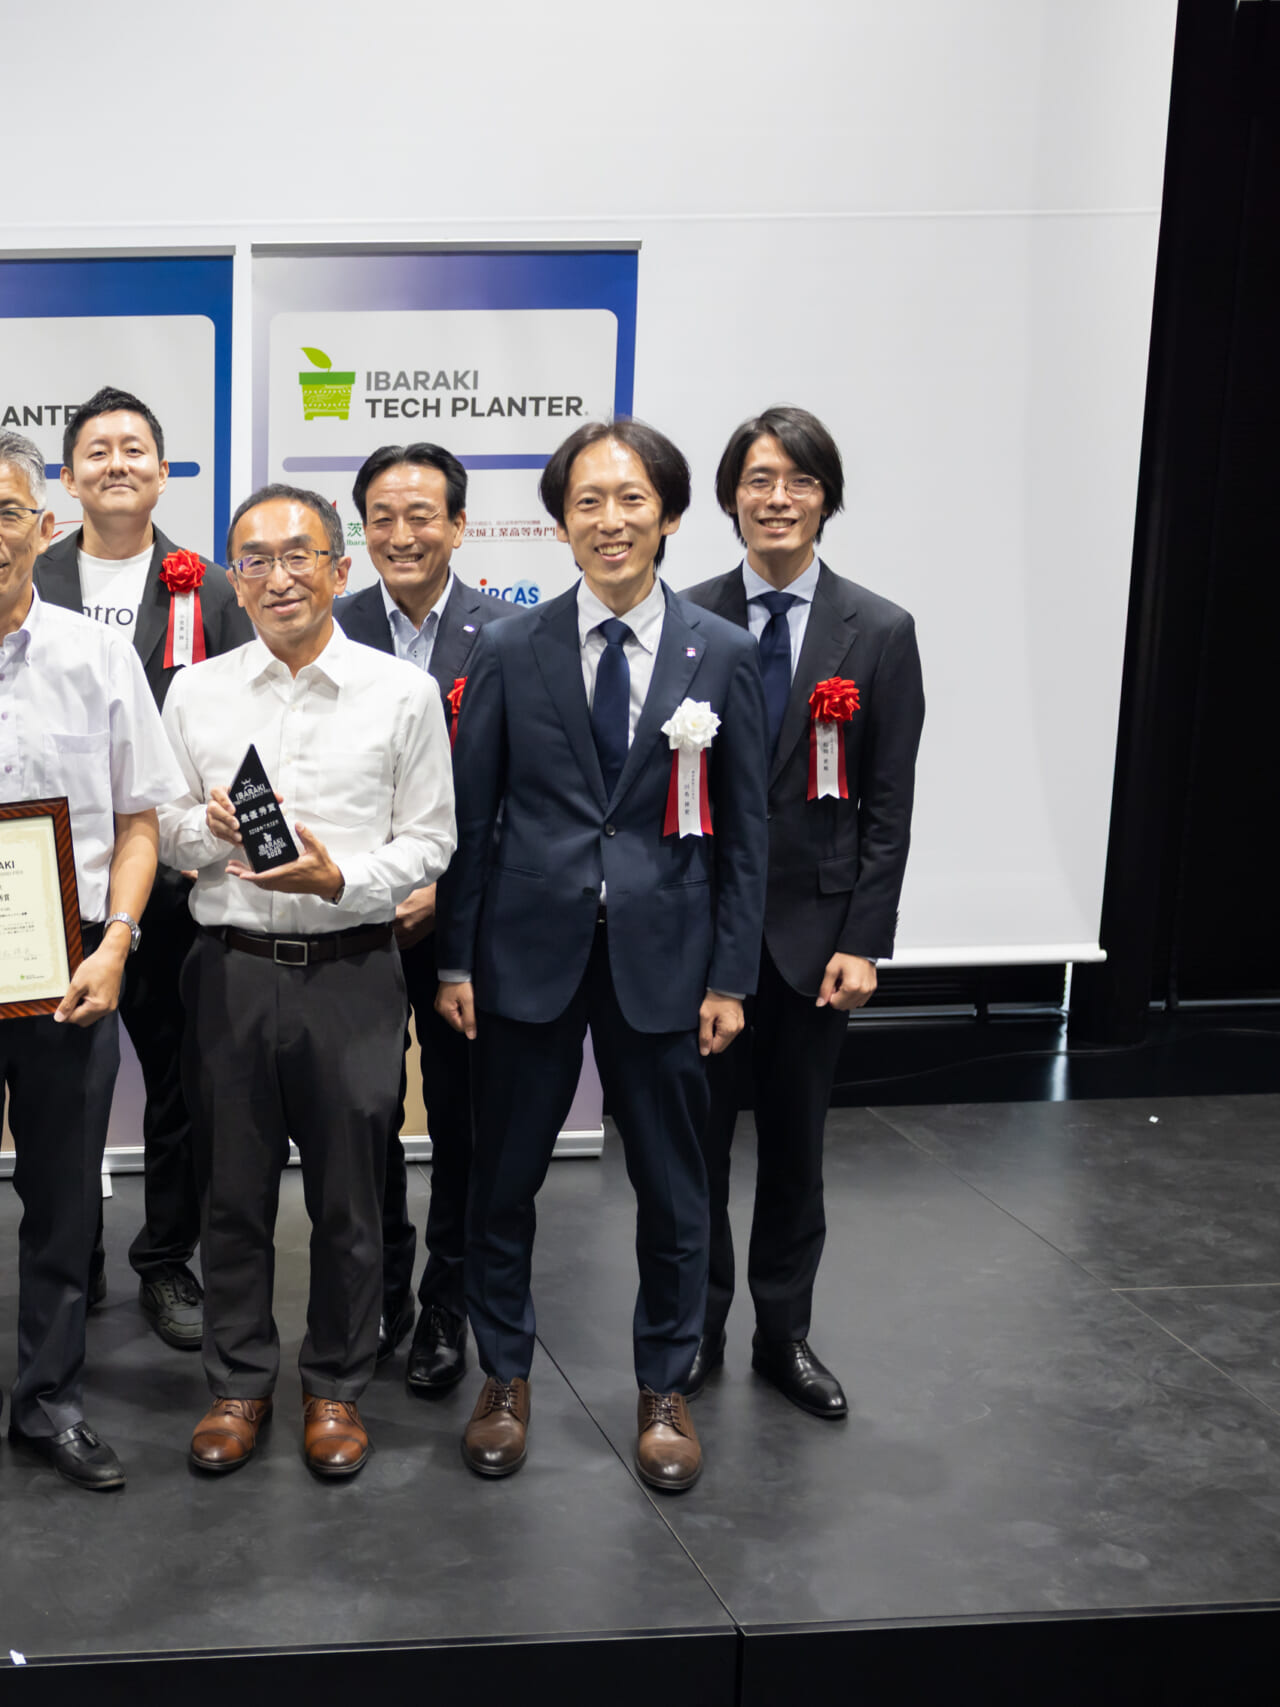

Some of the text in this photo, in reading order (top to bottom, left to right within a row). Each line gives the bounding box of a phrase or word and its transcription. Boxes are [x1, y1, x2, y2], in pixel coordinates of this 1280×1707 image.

[366, 370, 479, 391] IBARAKI
[365, 396, 583, 418] TECH PLANTER
